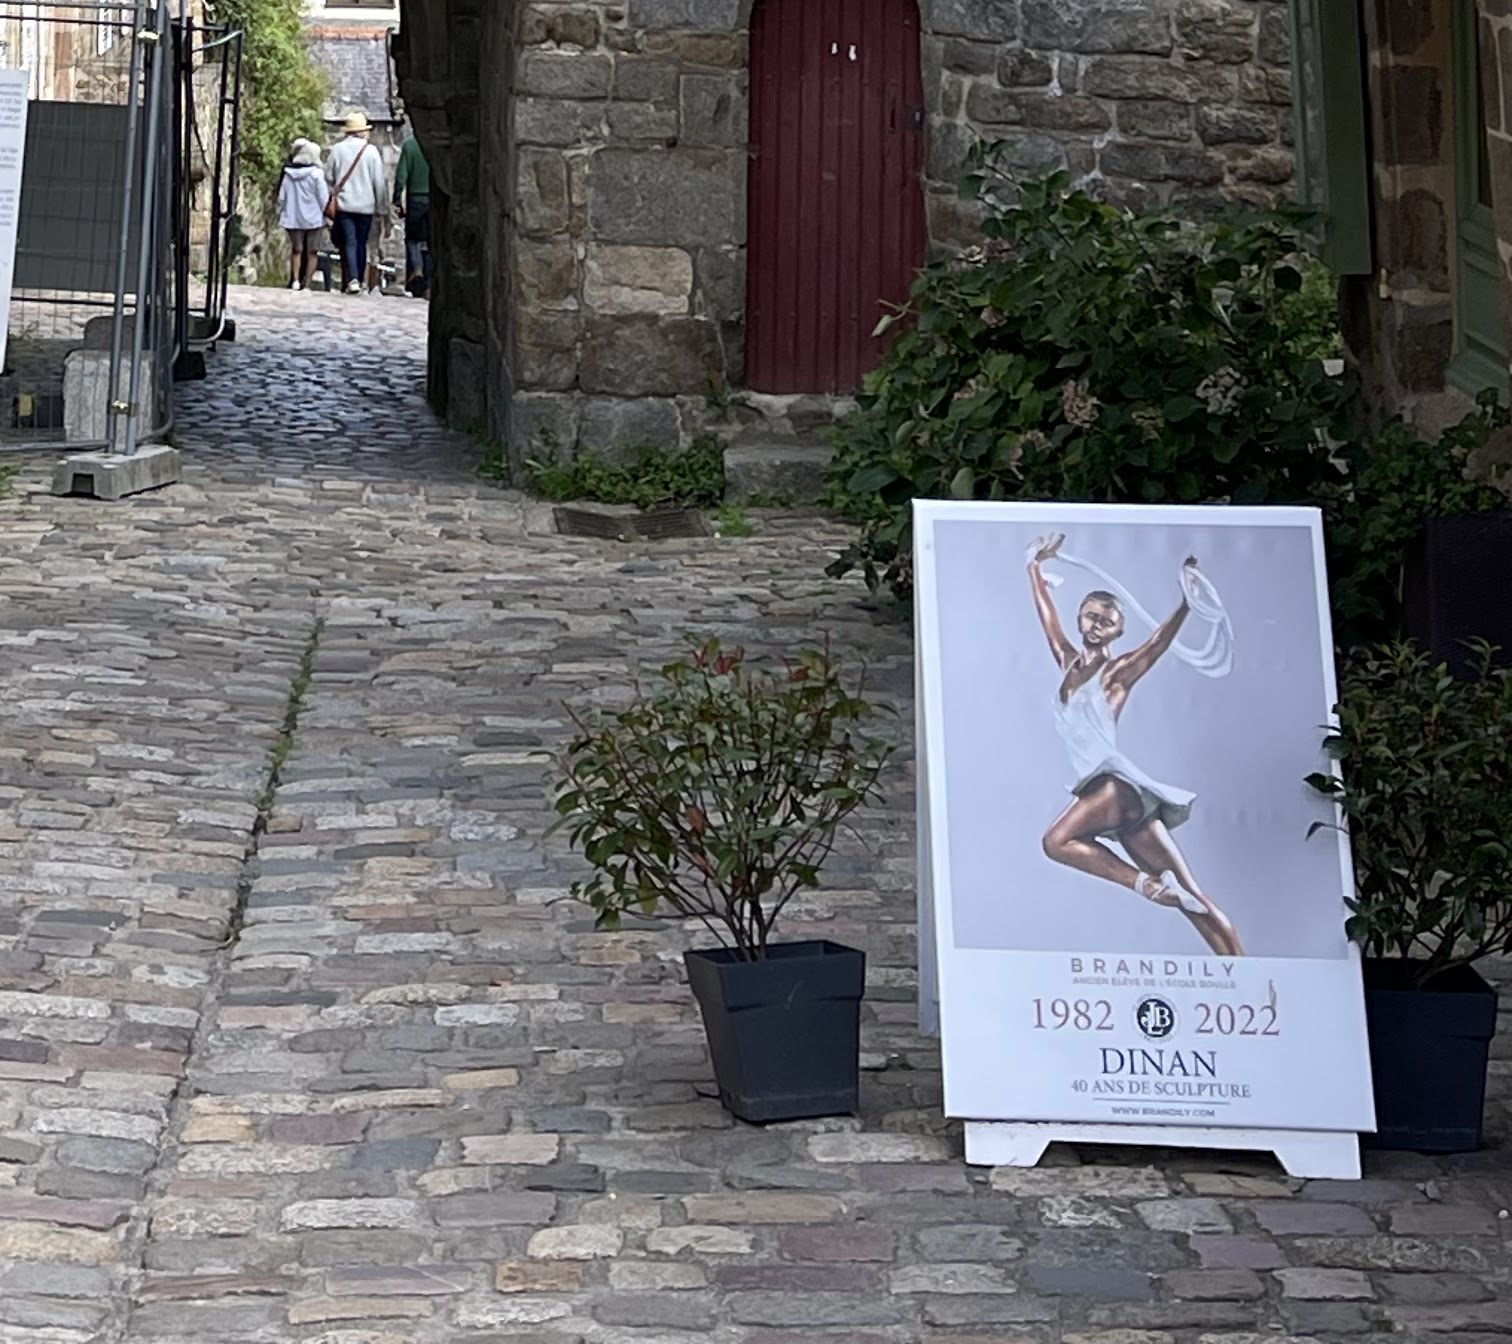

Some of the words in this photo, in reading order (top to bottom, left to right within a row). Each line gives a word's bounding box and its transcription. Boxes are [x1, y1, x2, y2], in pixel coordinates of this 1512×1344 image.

[1071, 958, 1235, 977] BRANDILY
[1032, 998, 1115, 1031] 1982
[1194, 1002, 1280, 1037] 2022
[1099, 1047, 1217, 1078] DINAN
[1071, 1079, 1088, 1094] 40
[1091, 1079, 1124, 1094] ANS
[1128, 1080, 1150, 1095] DE
[1154, 1081, 1252, 1098] SCULPTURE
